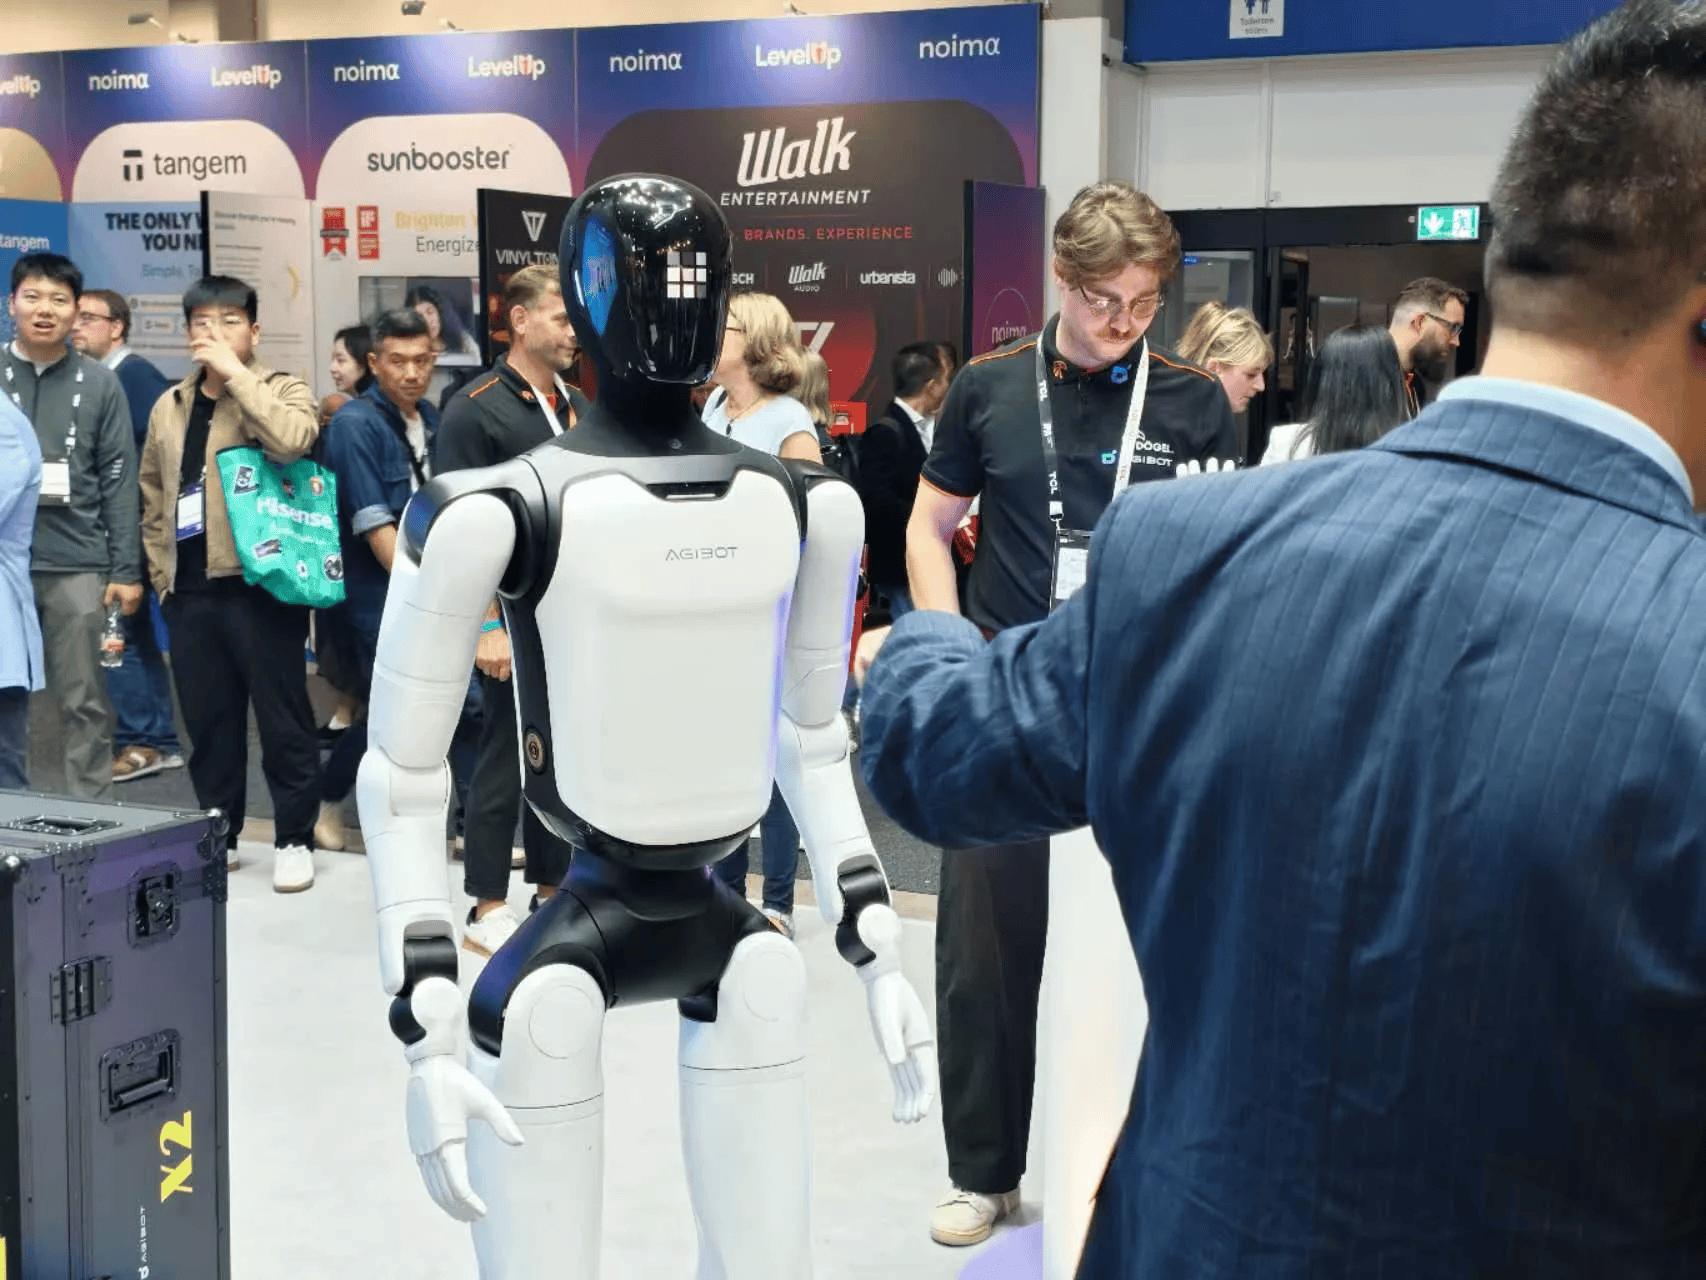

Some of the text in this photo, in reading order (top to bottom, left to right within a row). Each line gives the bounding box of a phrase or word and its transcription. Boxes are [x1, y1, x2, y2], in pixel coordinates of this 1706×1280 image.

[467, 54, 546, 80] LevelUp
[755, 41, 842, 69] LevelUp
[211, 65, 282, 89] LevelUp
[367, 142, 509, 171] sunbooster
[736, 116, 859, 187] Walk
[153, 153, 247, 181] tangem
[720, 189, 871, 207] ENTERTAINMENT
[105, 212, 140, 231] THE
[143, 211, 193, 231] ONLY
[141, 232, 181, 252] YOU
[815, 226, 914, 241] EXPERIENCE
[788, 261, 828, 285] Walk
[860, 270, 916, 285] urbanista
[793, 285, 820, 293] AUDIO
[1048, 471, 1058, 495] TCL
[664, 546, 738, 561] AGIBOT
[160, 1110, 193, 1203] X2
